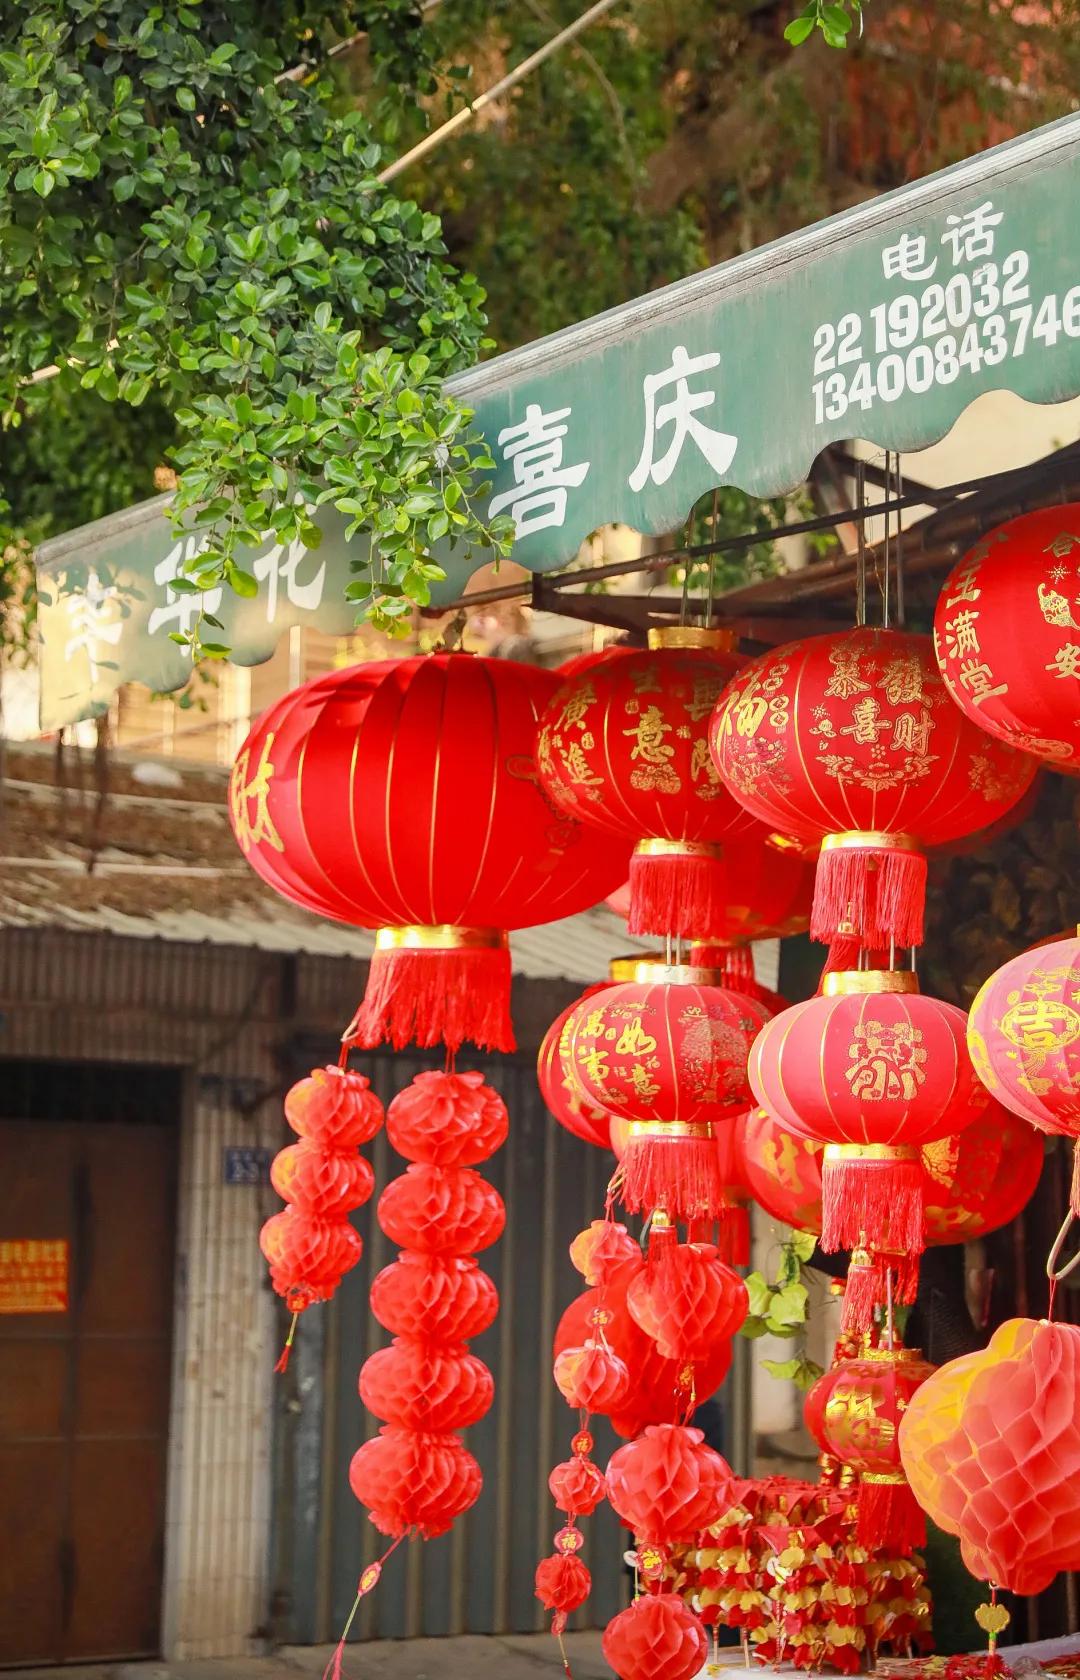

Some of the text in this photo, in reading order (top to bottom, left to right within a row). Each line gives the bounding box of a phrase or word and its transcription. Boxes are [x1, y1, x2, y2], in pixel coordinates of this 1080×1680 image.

[882, 201, 1004, 281] 电话
[812, 285, 1080, 424] 13400843746
[488, 345, 738, 541] 喜庆
